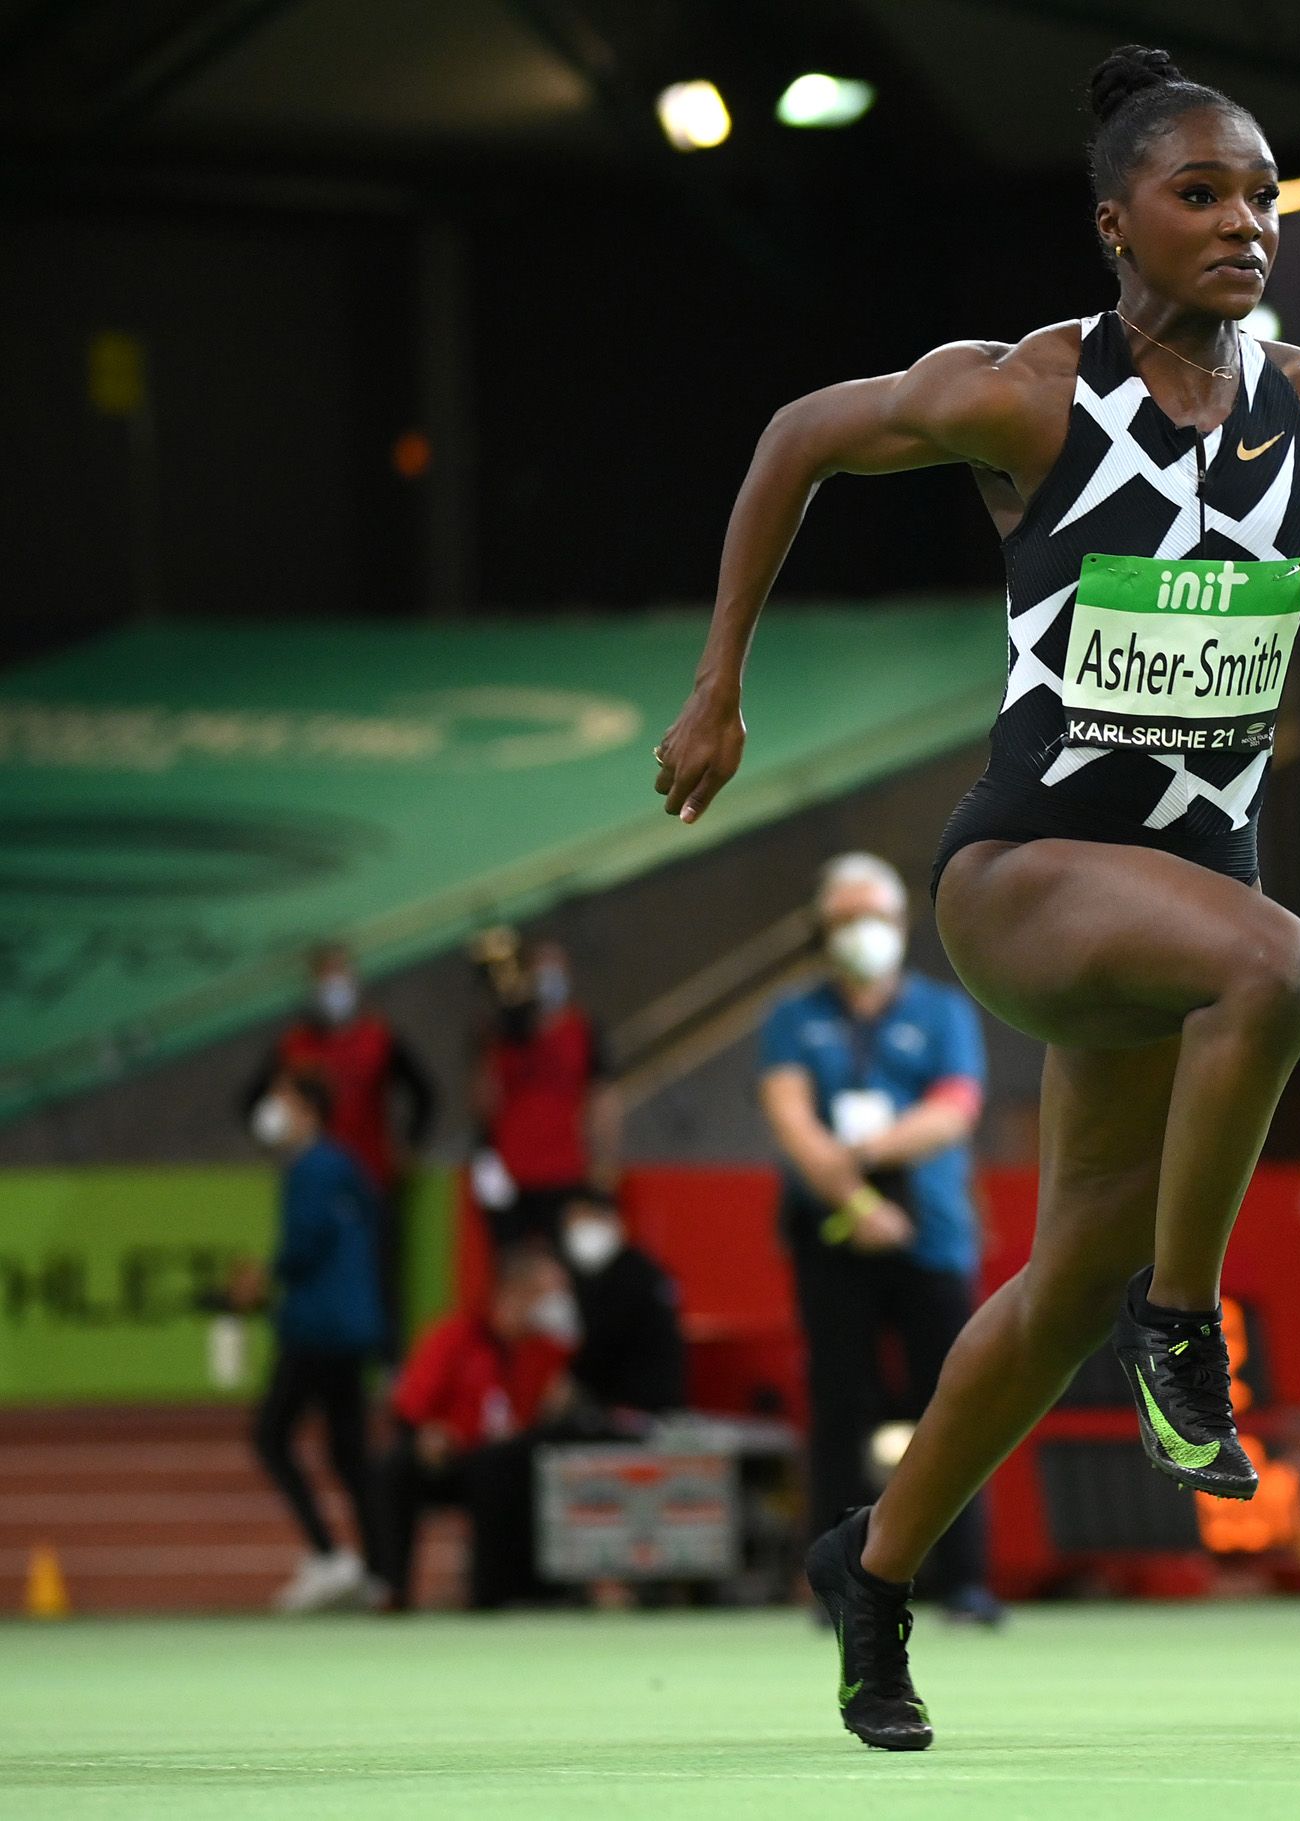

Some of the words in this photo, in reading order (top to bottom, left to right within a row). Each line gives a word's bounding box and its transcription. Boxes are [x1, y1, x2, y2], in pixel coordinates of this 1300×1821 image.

[1157, 561, 1250, 612] init
[1075, 629, 1283, 697] Asher-Smith
[1069, 719, 1207, 749] KARLSRUHE
[1210, 728, 1236, 748] 21
